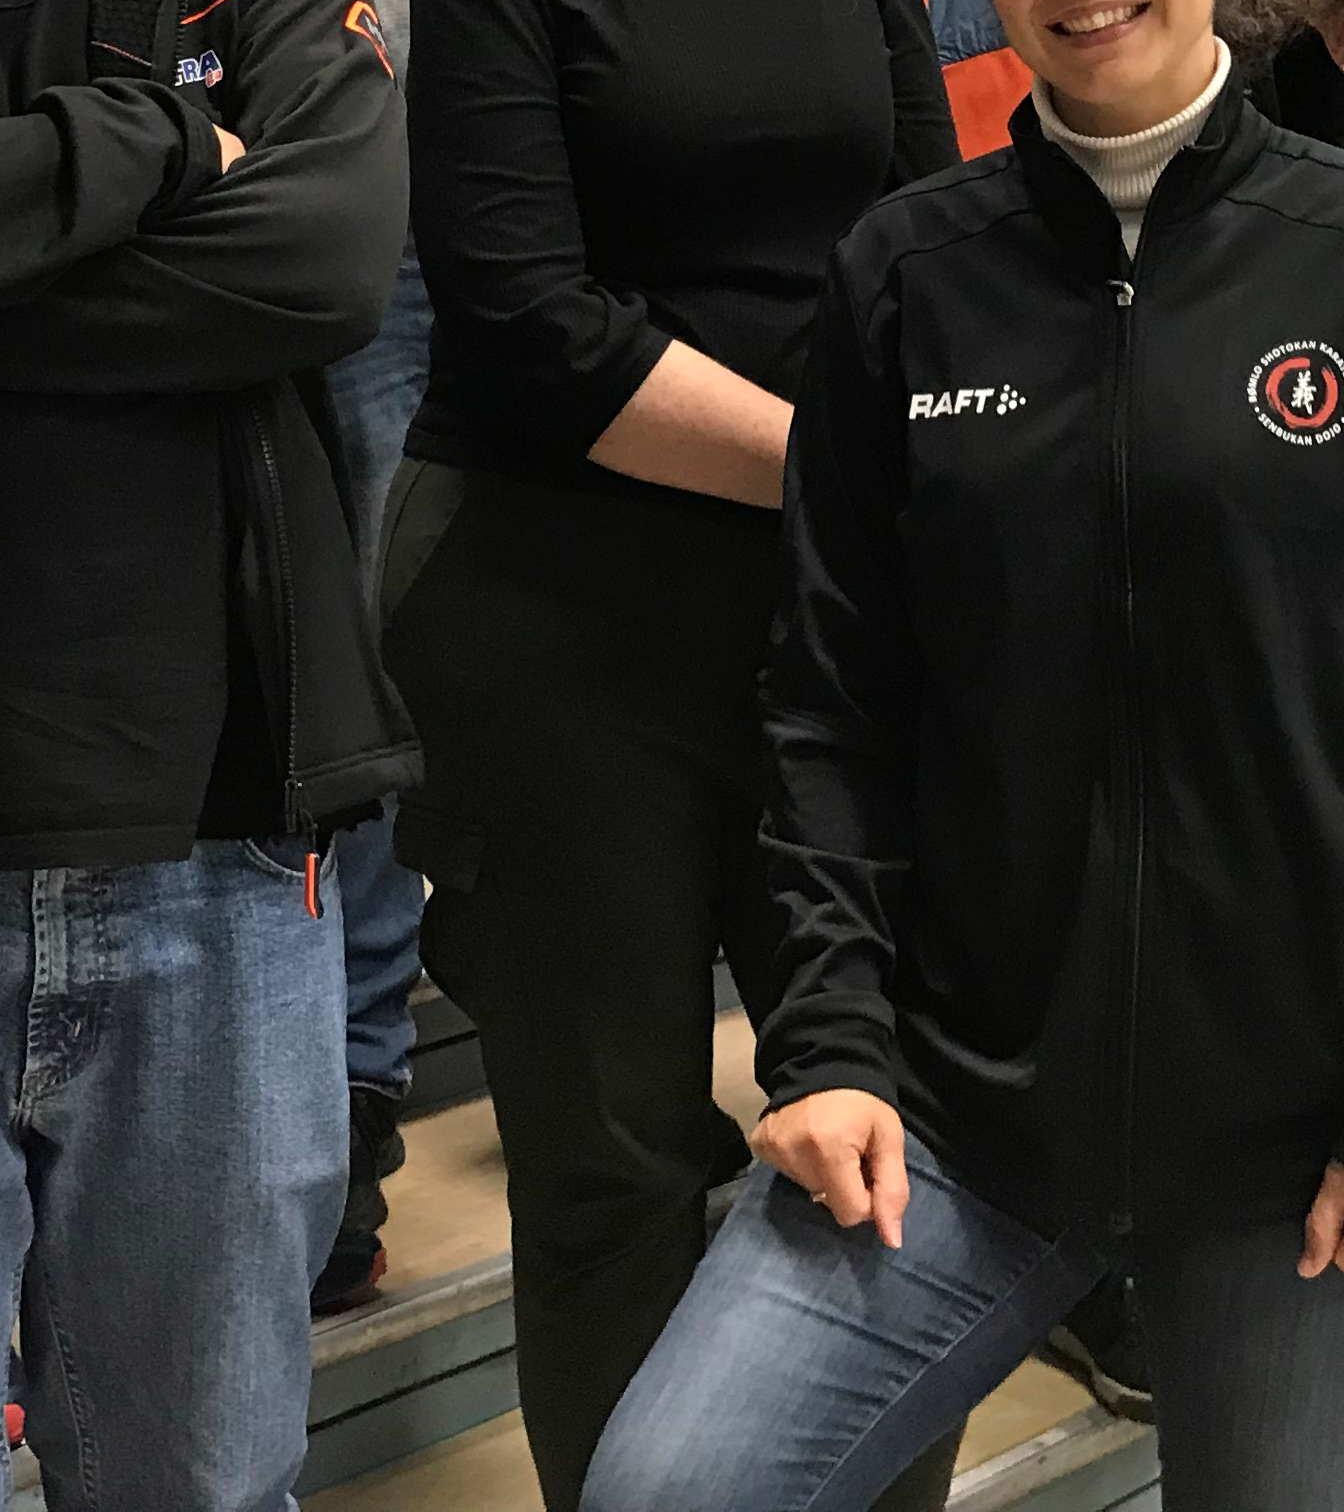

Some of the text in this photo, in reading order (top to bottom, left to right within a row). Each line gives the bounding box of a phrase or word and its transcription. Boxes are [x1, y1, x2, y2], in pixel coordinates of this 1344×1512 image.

[174, 49, 223, 87] RA
[1260, 340, 1317, 367] SHOTOKAN
[1258, 412, 1342, 446] SENBUKAN DOJO
